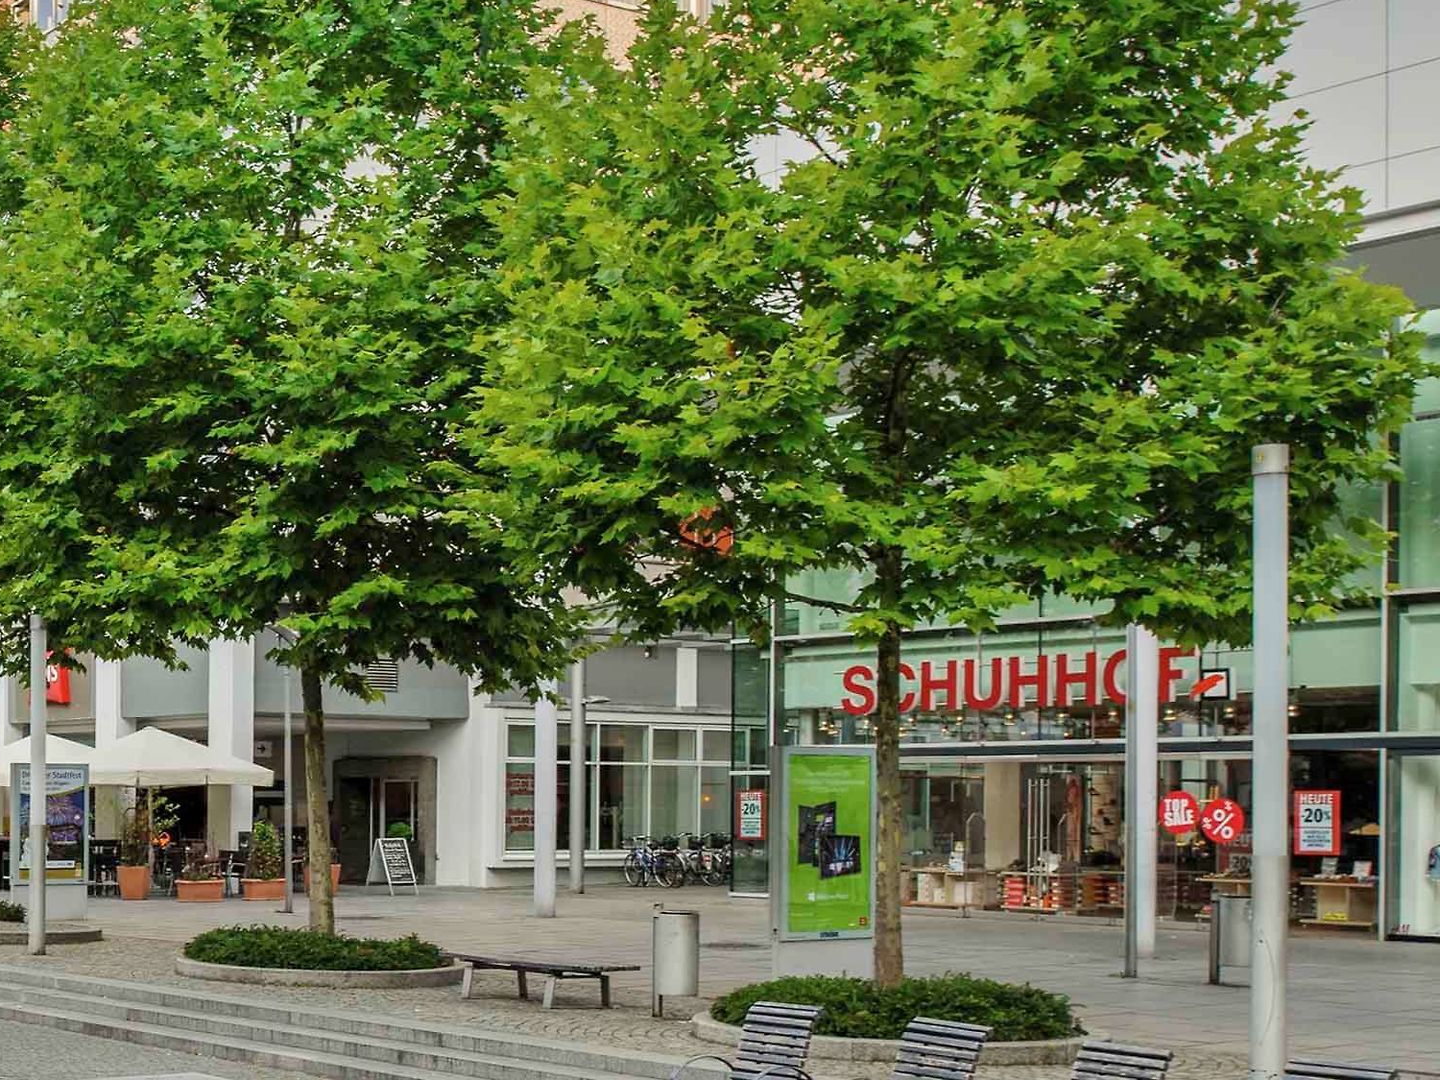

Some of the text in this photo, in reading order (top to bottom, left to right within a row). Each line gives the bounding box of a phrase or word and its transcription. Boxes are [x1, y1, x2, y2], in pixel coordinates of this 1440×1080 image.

[1164, 798, 1189, 813] TOP
[1300, 793, 1333, 804] HEUTE
[1164, 809, 1195, 827] SALE
[1301, 808, 1332, 823] -20%
